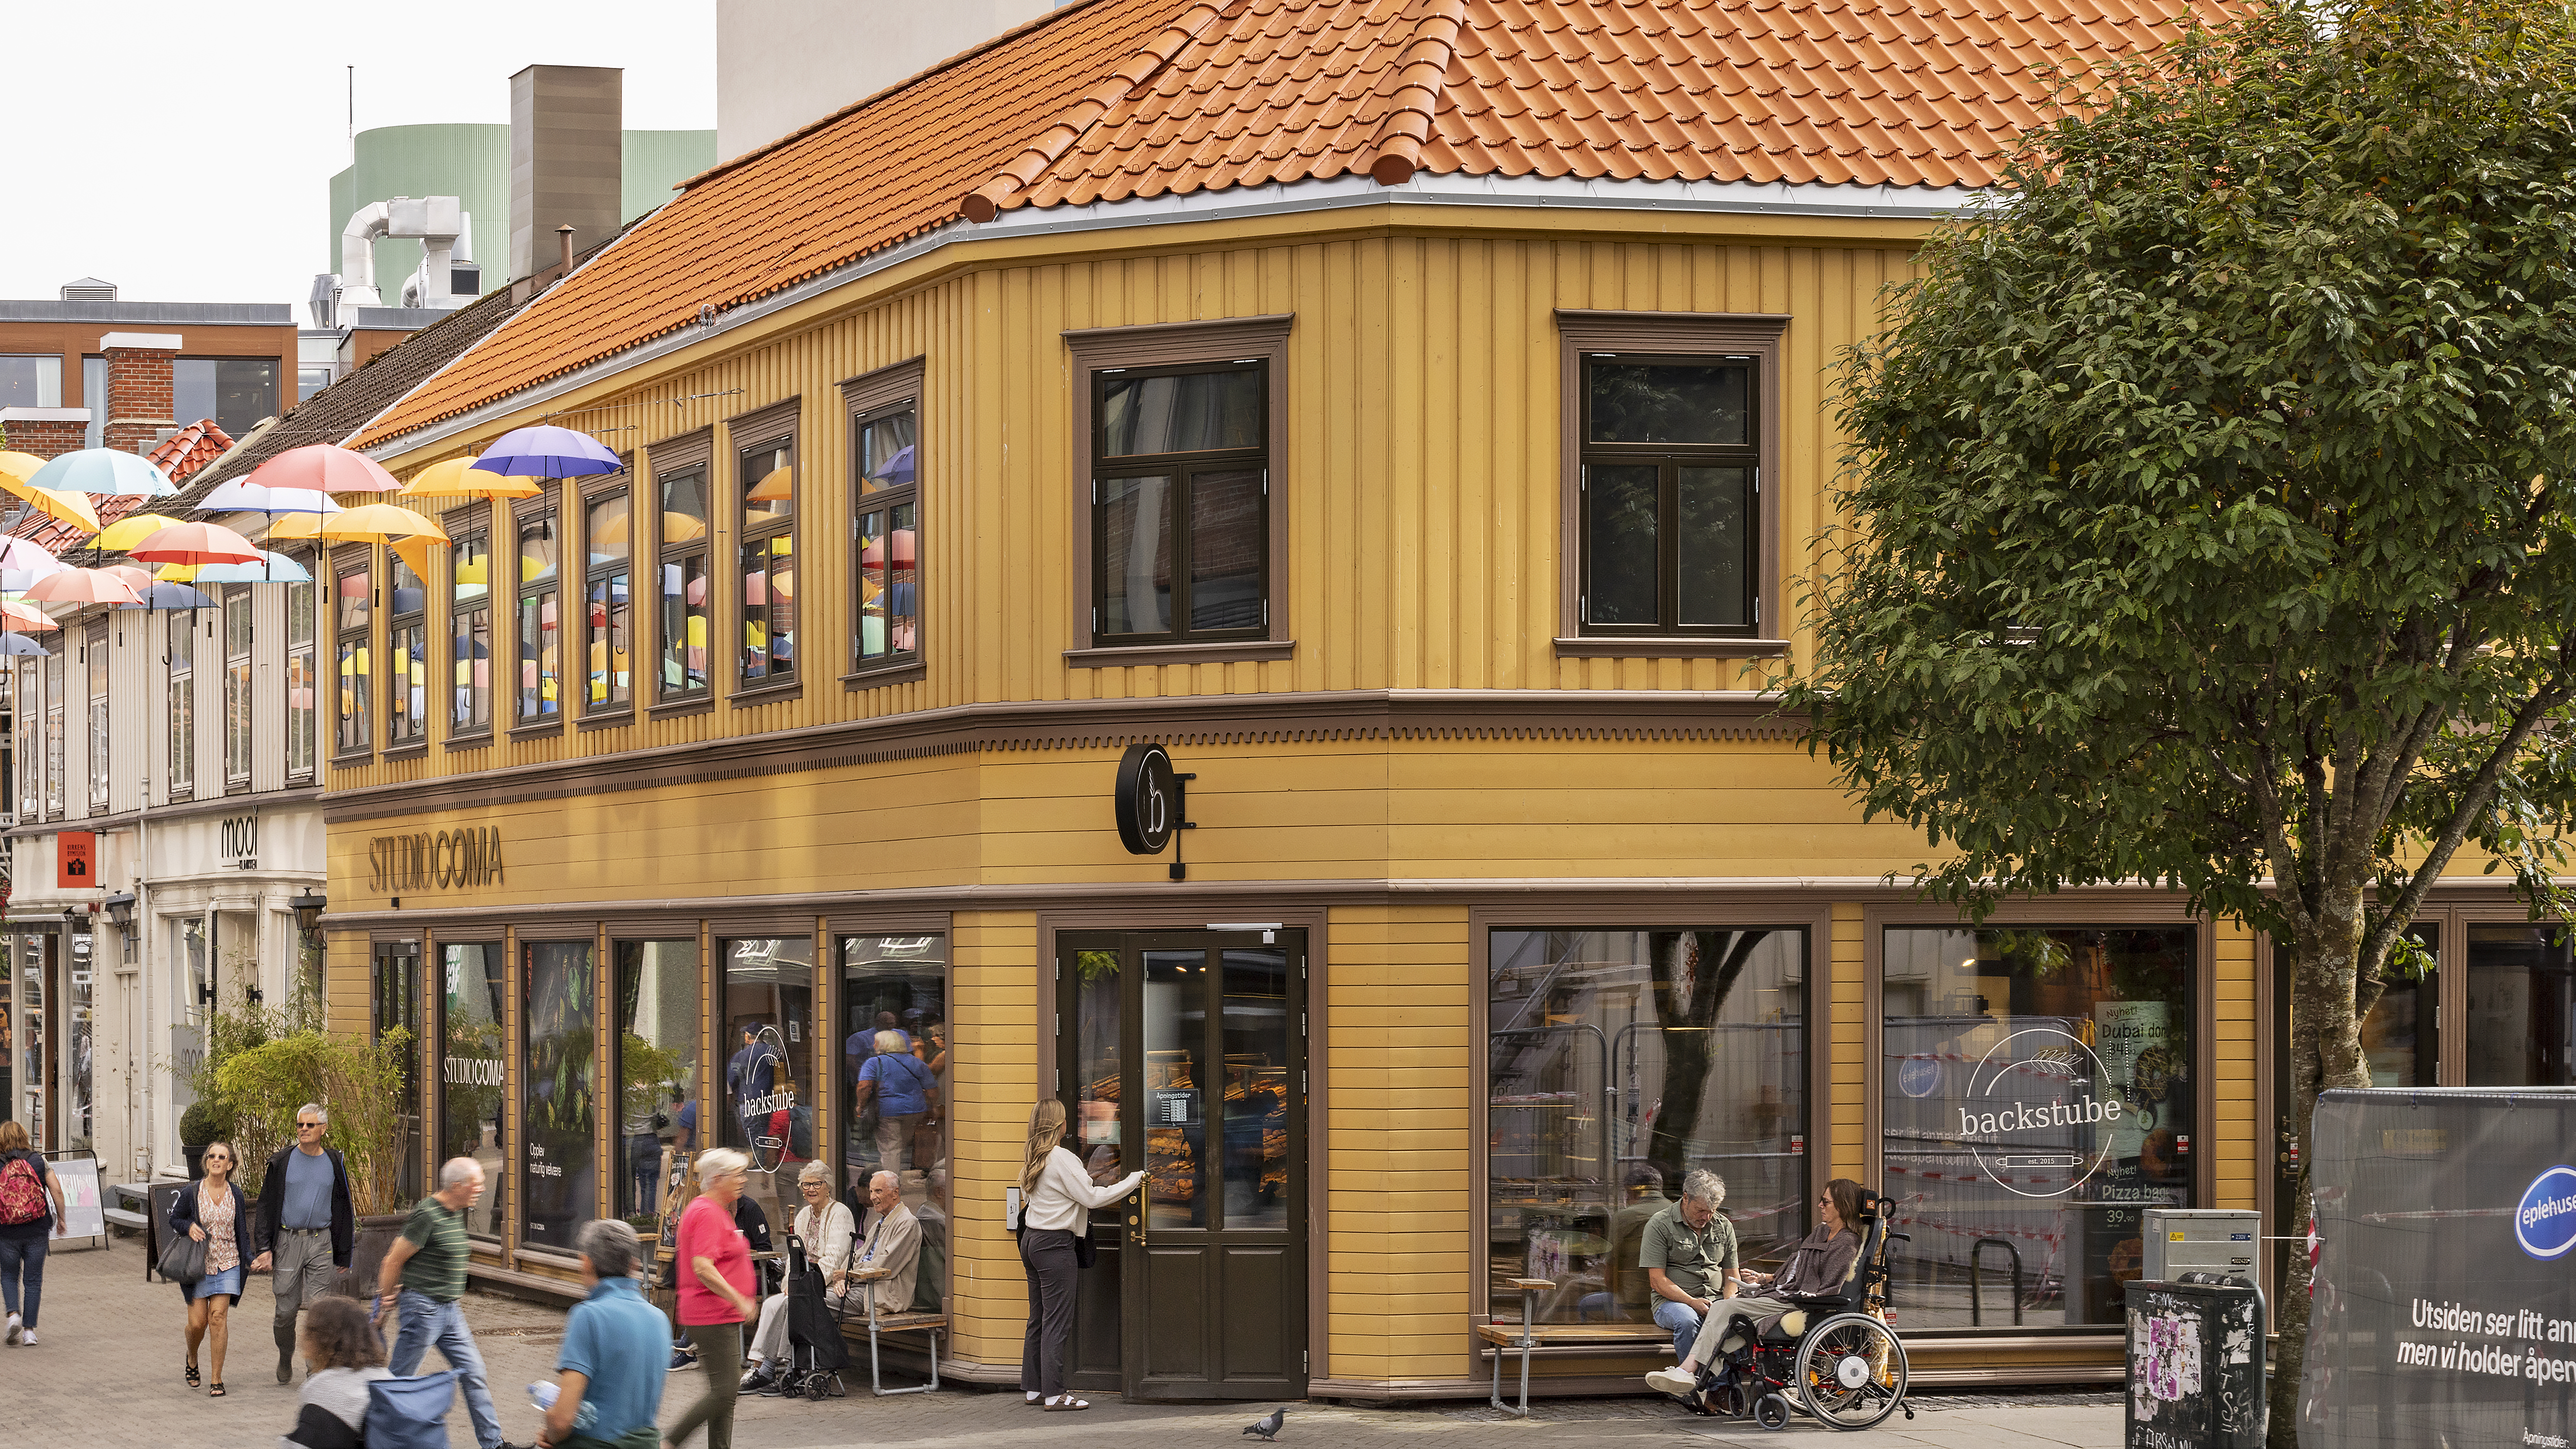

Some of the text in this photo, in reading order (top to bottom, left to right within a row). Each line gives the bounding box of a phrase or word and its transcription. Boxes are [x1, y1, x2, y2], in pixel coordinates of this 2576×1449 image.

[1148, 766, 1165, 833] b
[221, 805, 258, 858] mooi
[369, 825, 503, 892] STUDIOCOMA
[2107, 1006, 2137, 1019] Nyhet!
[2102, 1023, 2144, 1038] Dubai
[444, 1057, 503, 1086] STUDIOCOMA
[744, 1085, 794, 1117] backstube
[1958, 1094, 2122, 1135] backstube
[530, 1143, 545, 1159] Opplev
[2107, 1165, 2137, 1179] Nyhet!
[2102, 1184, 2140, 1200] Pizza
[2107, 1210, 2135, 1223] 39.90
[2412, 1298, 2576, 1344] Utsiden ser litt an
[2397, 1340, 2576, 1386] men vi holder åpen
